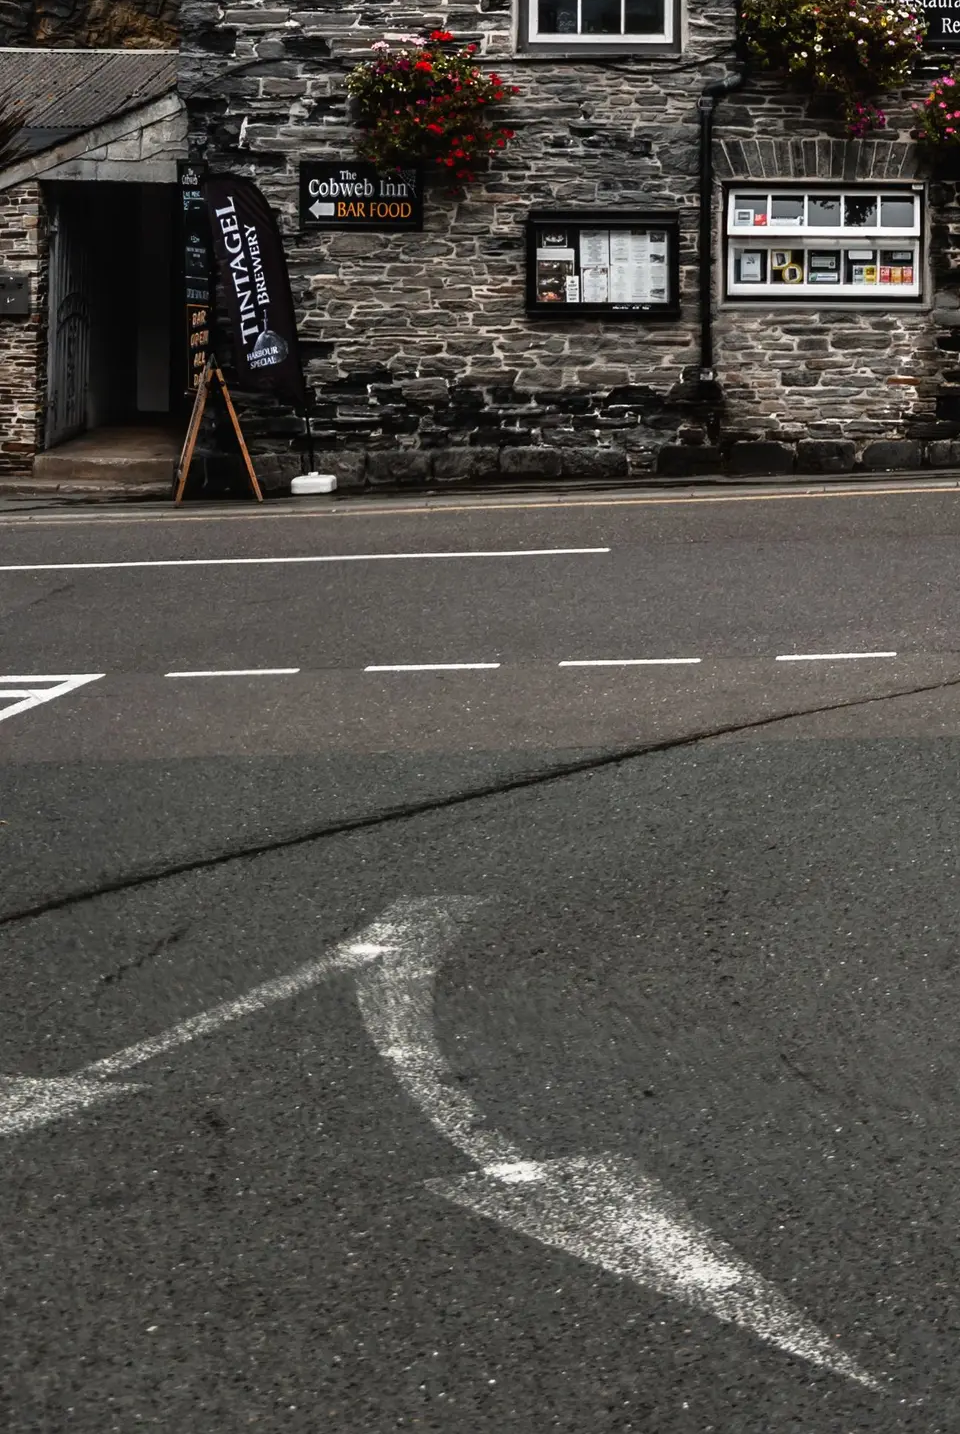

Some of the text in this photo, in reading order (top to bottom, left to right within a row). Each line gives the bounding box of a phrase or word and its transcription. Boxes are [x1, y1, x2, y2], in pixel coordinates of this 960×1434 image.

[339, 170, 357, 181] The
[308, 177, 408, 198] Cobweb Inn
[337, 201, 412, 218] BAR FOOD
[215, 196, 260, 345] TINTAGEL
[243, 224, 270, 306] BREWERY
[192, 309, 206, 327] BAR
[246, 345, 279, 363] HARBOUR
[249, 355, 277, 370] SPECIAL
